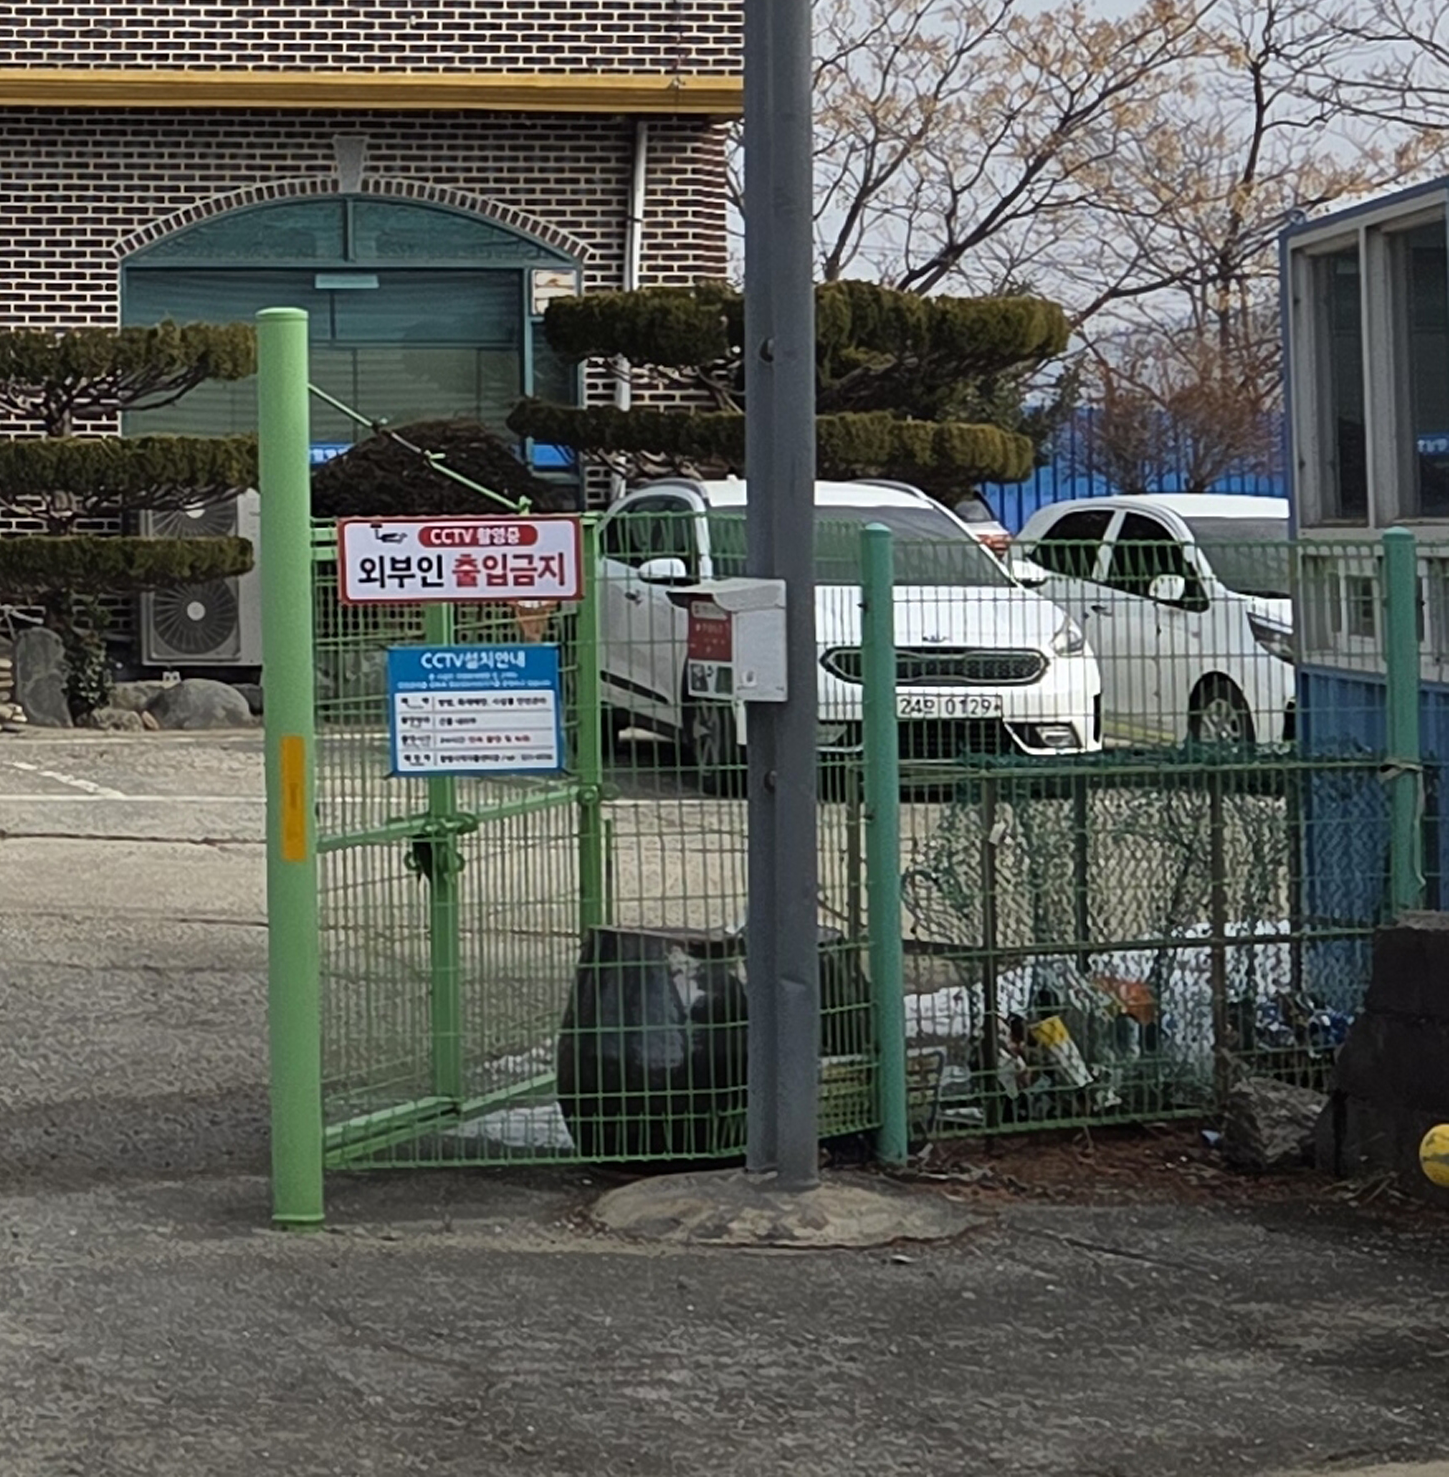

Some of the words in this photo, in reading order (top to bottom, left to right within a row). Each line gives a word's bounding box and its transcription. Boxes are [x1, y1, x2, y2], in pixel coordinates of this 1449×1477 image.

[430, 528, 474, 544] CCTV
[358, 554, 445, 588] 외부인
[452, 552, 565, 588] 출입금지
